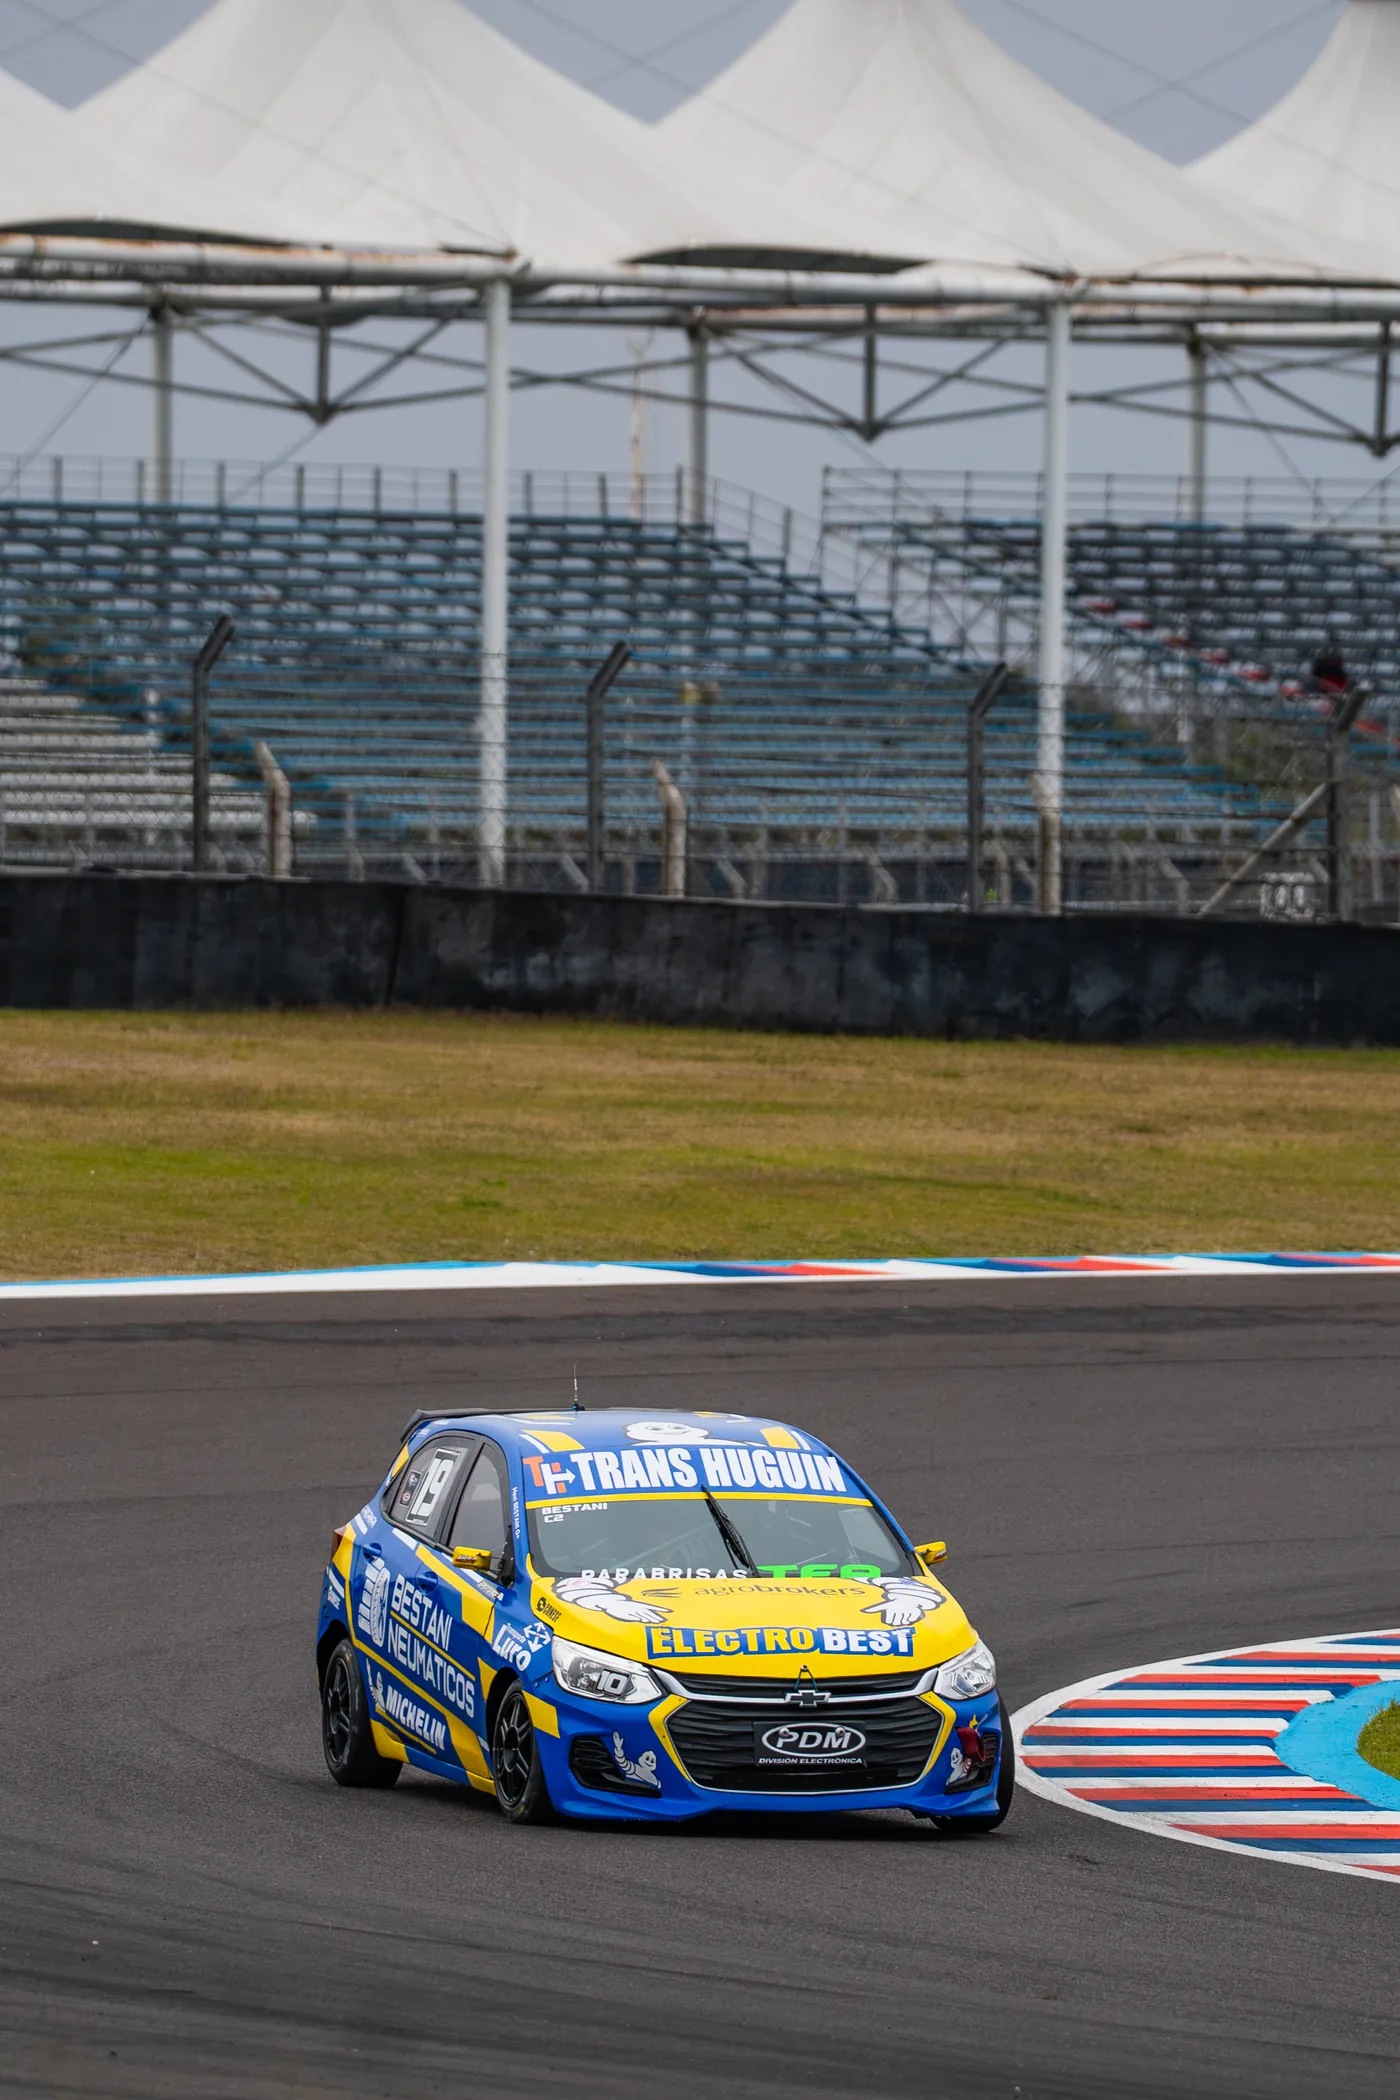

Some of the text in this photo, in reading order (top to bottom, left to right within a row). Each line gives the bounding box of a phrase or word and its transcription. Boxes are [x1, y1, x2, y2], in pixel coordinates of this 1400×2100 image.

[569, 1448, 698, 1491] TRANS
[698, 1448, 848, 1493] HUGUIN
[541, 1502, 608, 1515] BESTANI
[544, 1514, 564, 1523] C2
[581, 1567, 748, 1579] PARABRISAS
[695, 1584, 866, 1596] agrobrokers
[391, 1573, 453, 1652] BESTANI
[492, 1624, 532, 1671] Luro
[650, 1626, 914, 1654] ELECTRO BEST
[387, 1618, 476, 1719] NEUMATICOS
[597, 1671, 628, 1695] 10
[385, 1685, 446, 1751] MICHELIN
[776, 1731, 852, 1749] PDM
